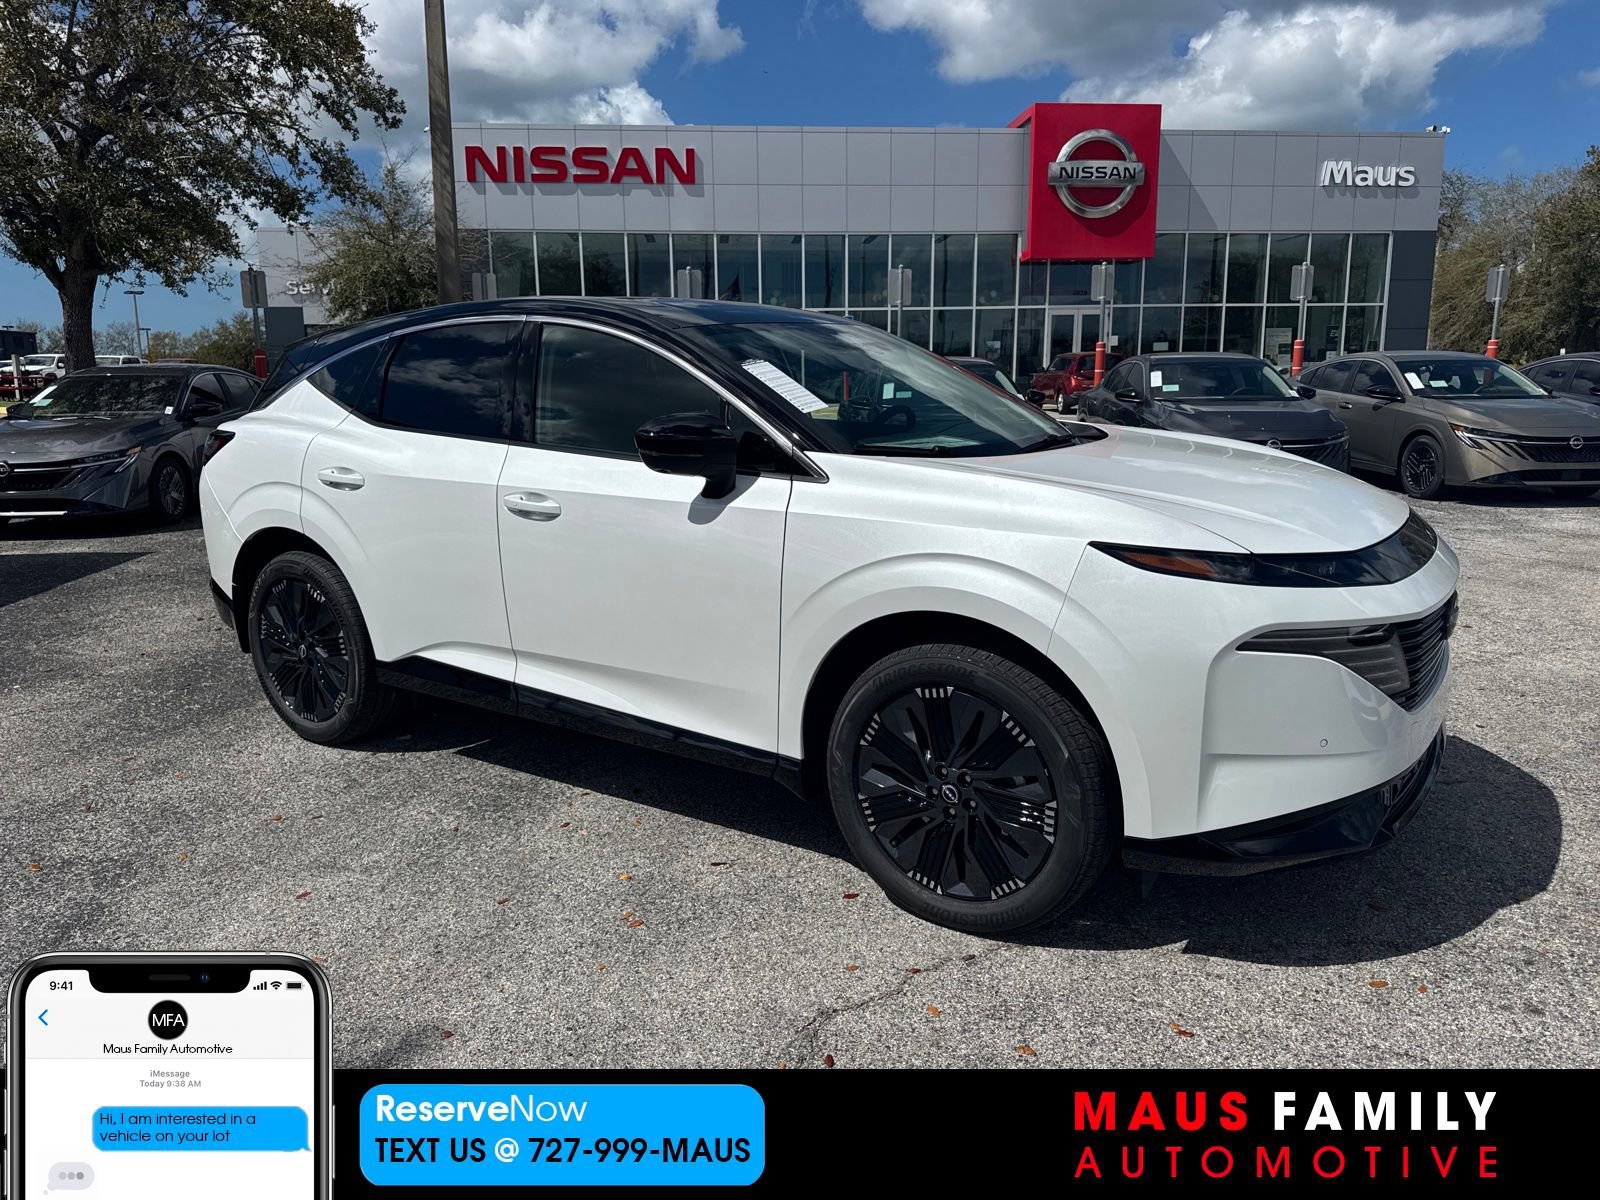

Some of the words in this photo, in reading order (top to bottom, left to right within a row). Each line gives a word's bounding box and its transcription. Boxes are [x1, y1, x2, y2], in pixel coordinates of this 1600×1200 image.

[464, 145, 696, 185] NISSAN
[1059, 166, 1137, 180] NISSAN
[1320, 160, 1416, 187] Maus
